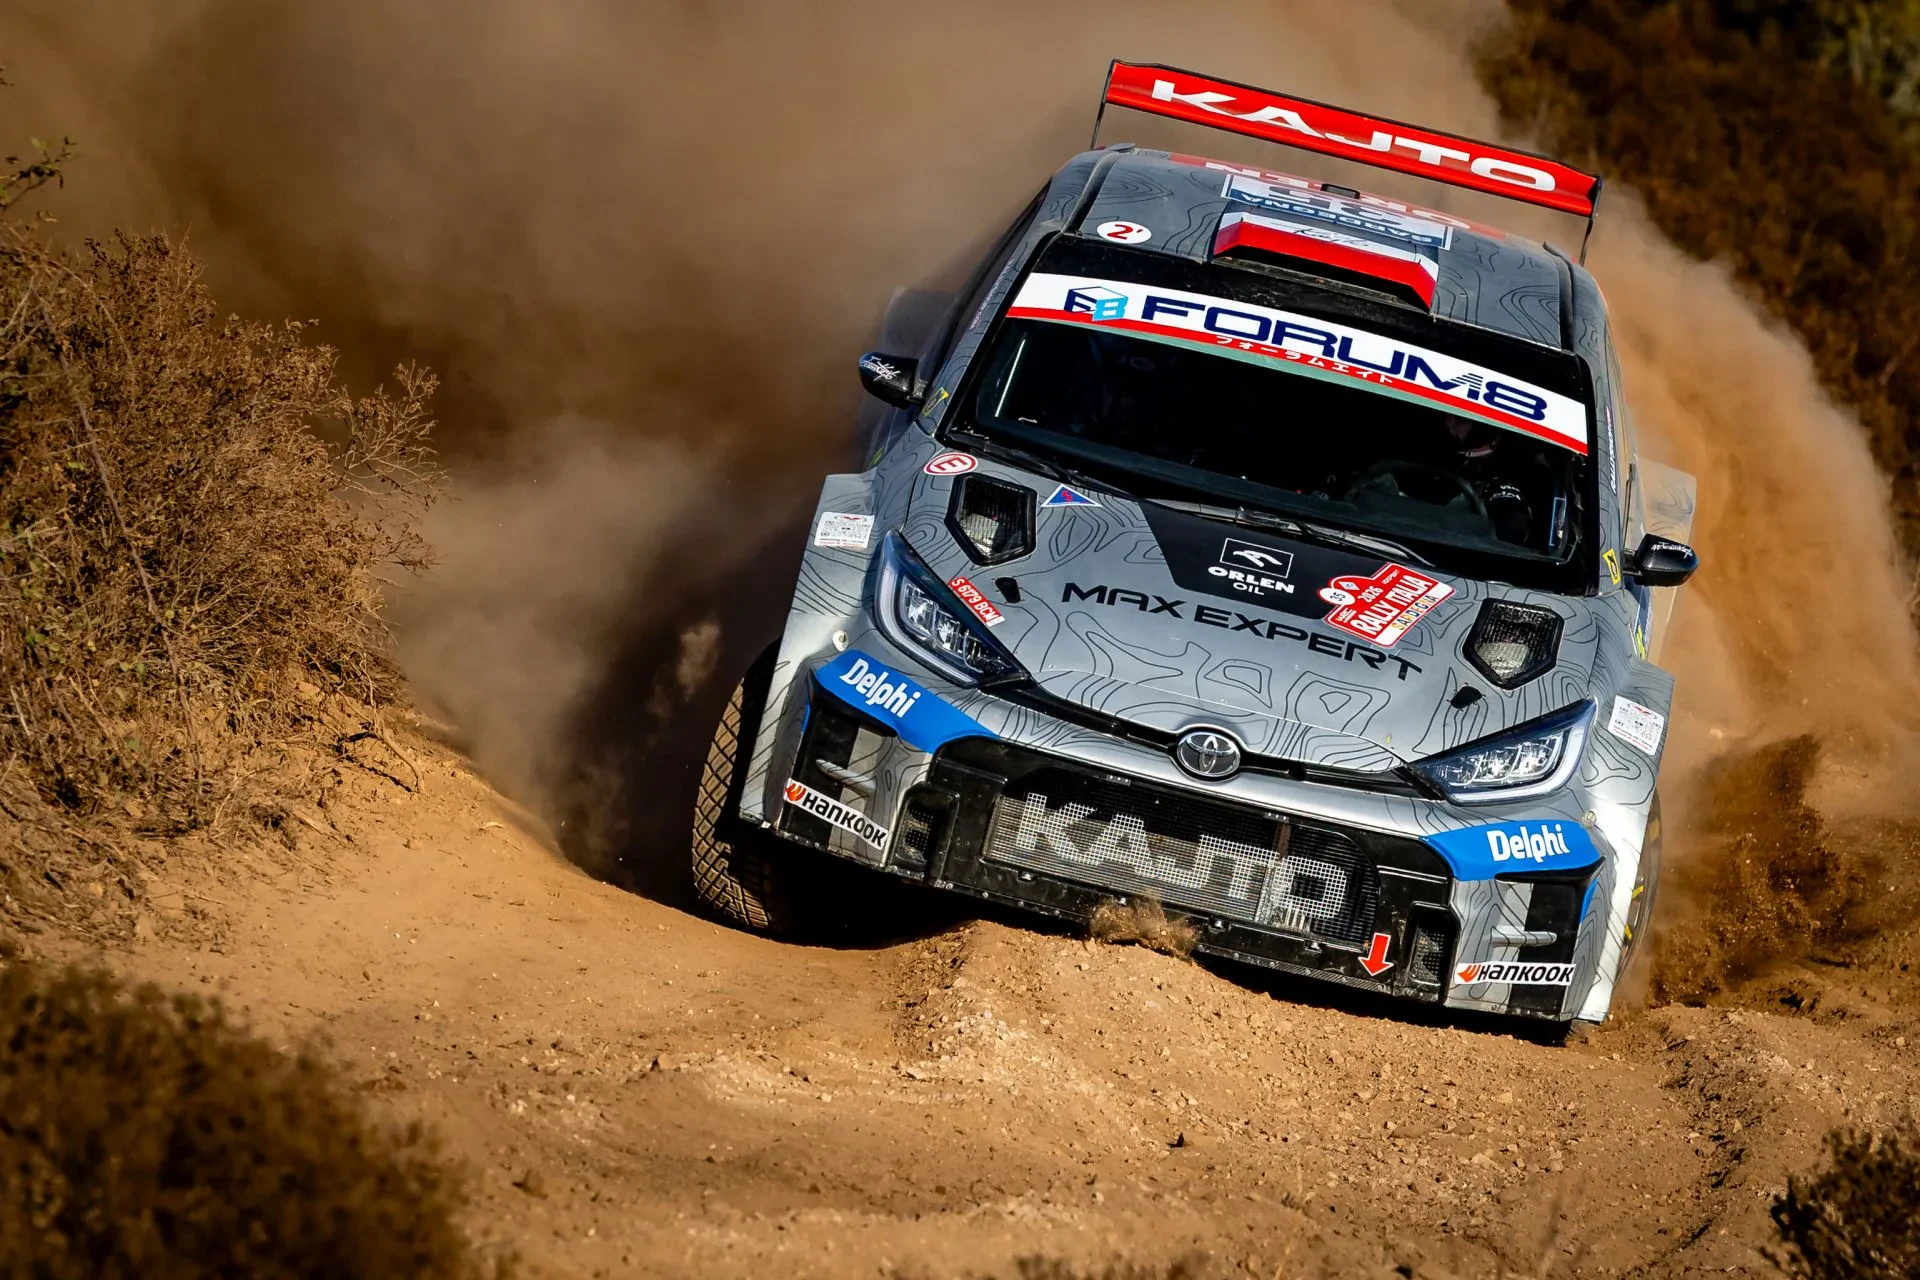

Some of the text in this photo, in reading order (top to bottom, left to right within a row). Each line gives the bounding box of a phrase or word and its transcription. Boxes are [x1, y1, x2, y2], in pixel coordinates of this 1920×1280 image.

[1152, 79, 1555, 192] KAJTO
[1205, 161, 1471, 229] OREN
[1240, 193, 1433, 243] SARDEGNA
[1141, 295, 1548, 421] FORUM8
[951, 578, 1000, 622] S 6179 BCM
[1208, 566, 1295, 595] ORLEN
[1233, 582, 1265, 596] OIL
[1330, 591, 1346, 602] 35
[1350, 600, 1401, 636] RALLY
[1384, 574, 1433, 607] ITALIA
[1061, 582, 1423, 682] MAX EXPERT
[1391, 595, 1439, 631] SARDEGNA
[839, 658, 922, 718] Delphi
[1015, 792, 1347, 919] KAJTO
[1487, 823, 1571, 863] Delphi
